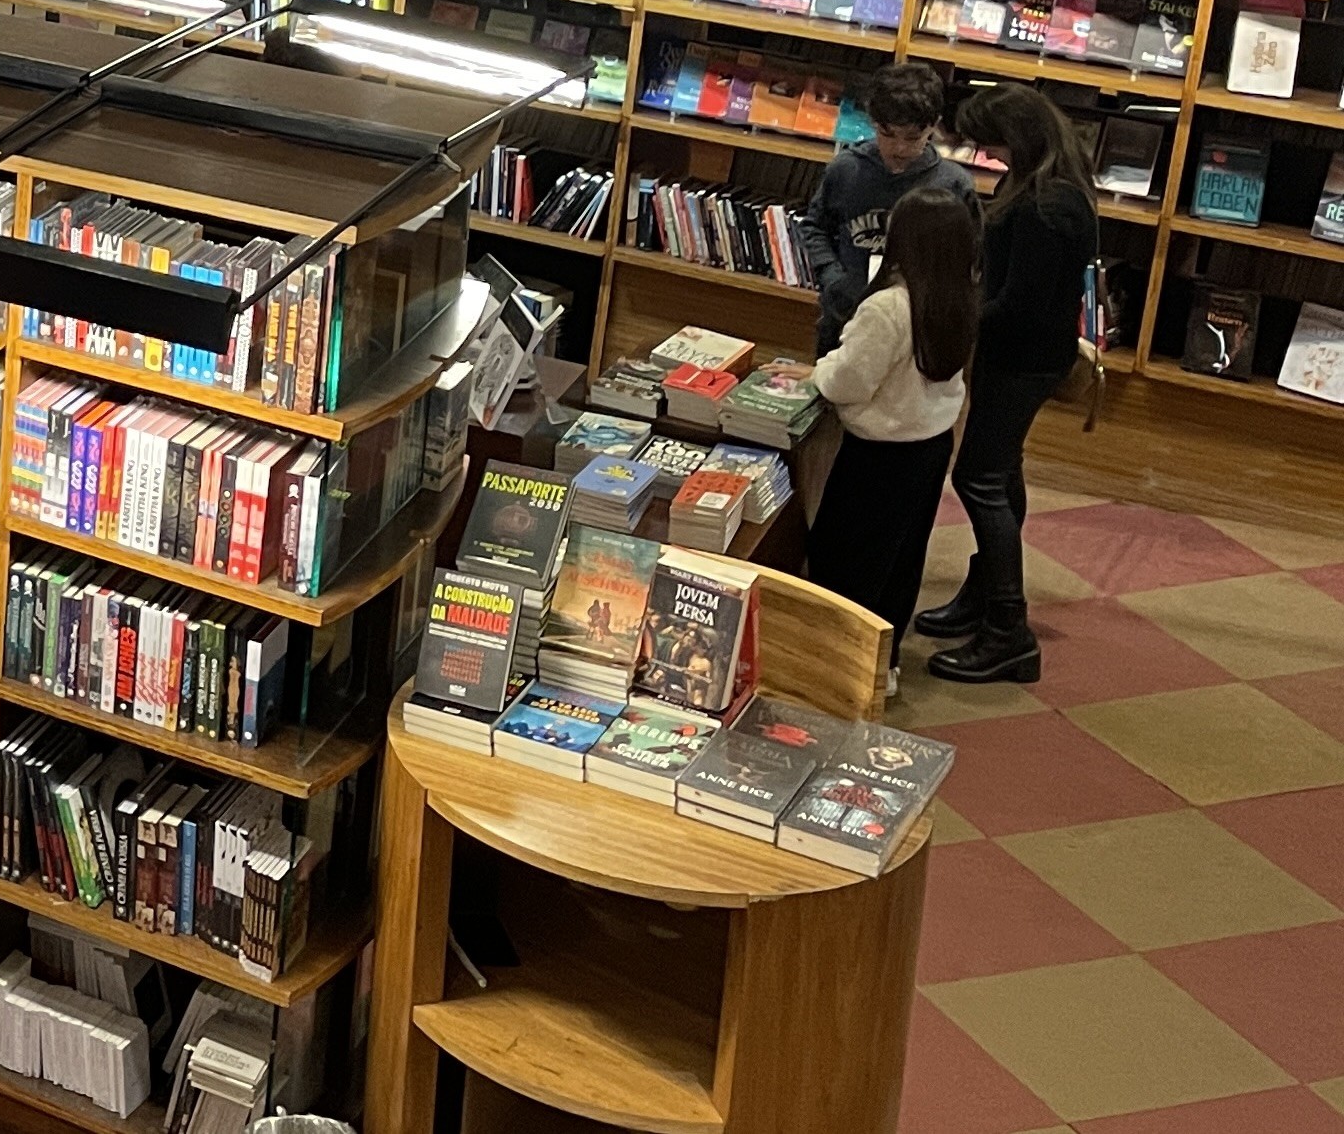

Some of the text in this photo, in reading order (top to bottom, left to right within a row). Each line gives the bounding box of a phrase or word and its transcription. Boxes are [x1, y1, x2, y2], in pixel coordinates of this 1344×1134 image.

[1009, 30, 1047, 44] PENN
[1200, 172, 1260, 196] HARLAN
[1198, 192, 1259, 214] COBEN
[482, 472, 567, 503] PASSAPORTE
[529, 497, 561, 512] 2030
[445, 572, 509, 594] ROBERTO MOTTA
[675, 583, 720, 610] JOVEM
[434, 583, 515, 614] A CONSTRUÇÃO
[431, 603, 511, 635] DA MALDADE
[675, 600, 715, 626] PERSA
[696, 771, 774, 800] ANNE RICE
[838, 763, 916, 790] ANNE RICE
[797, 812, 876, 839] ANNE RICE
